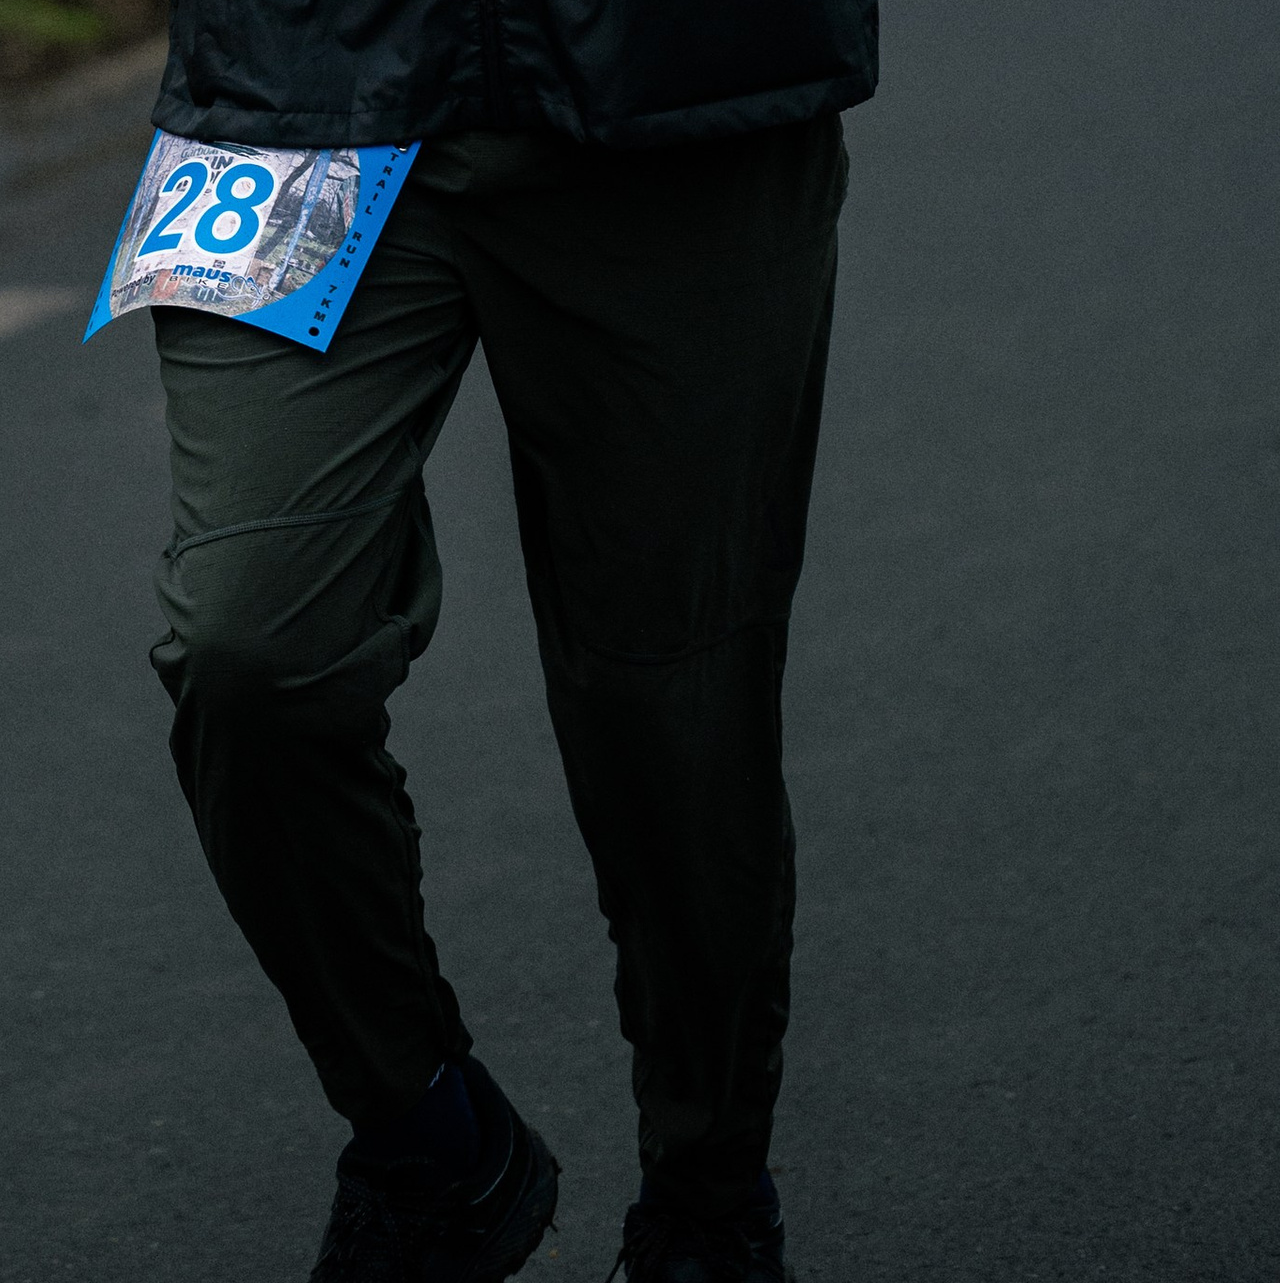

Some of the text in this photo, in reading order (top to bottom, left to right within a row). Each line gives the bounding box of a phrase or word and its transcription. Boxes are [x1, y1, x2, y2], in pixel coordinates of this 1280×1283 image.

[136, 160, 276, 259] 28
[313, 152, 399, 323] TRAIL RUN 7KM
[143, 274, 157, 286] by
[169, 276, 230, 290] BIKE
[172, 264, 233, 283] maus
